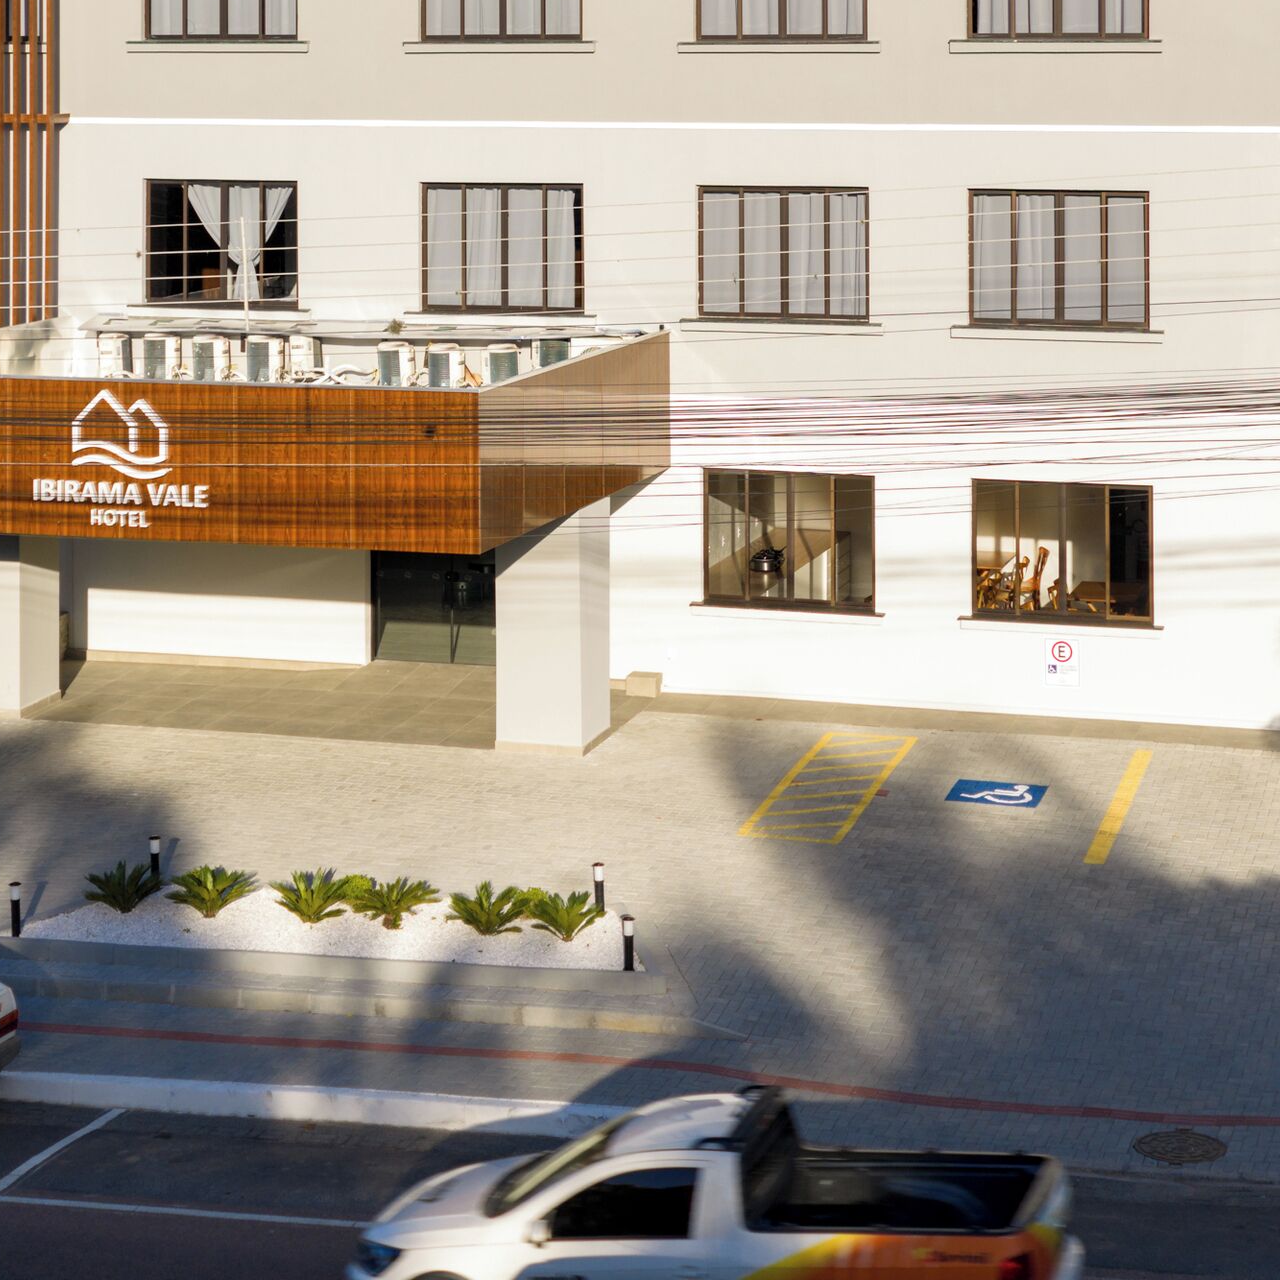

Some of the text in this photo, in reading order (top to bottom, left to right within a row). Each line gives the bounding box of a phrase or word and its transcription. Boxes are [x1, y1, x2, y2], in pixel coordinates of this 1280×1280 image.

[32, 478, 210, 508] IBIRAMA VALE
[90, 508, 151, 528] HOTEL
